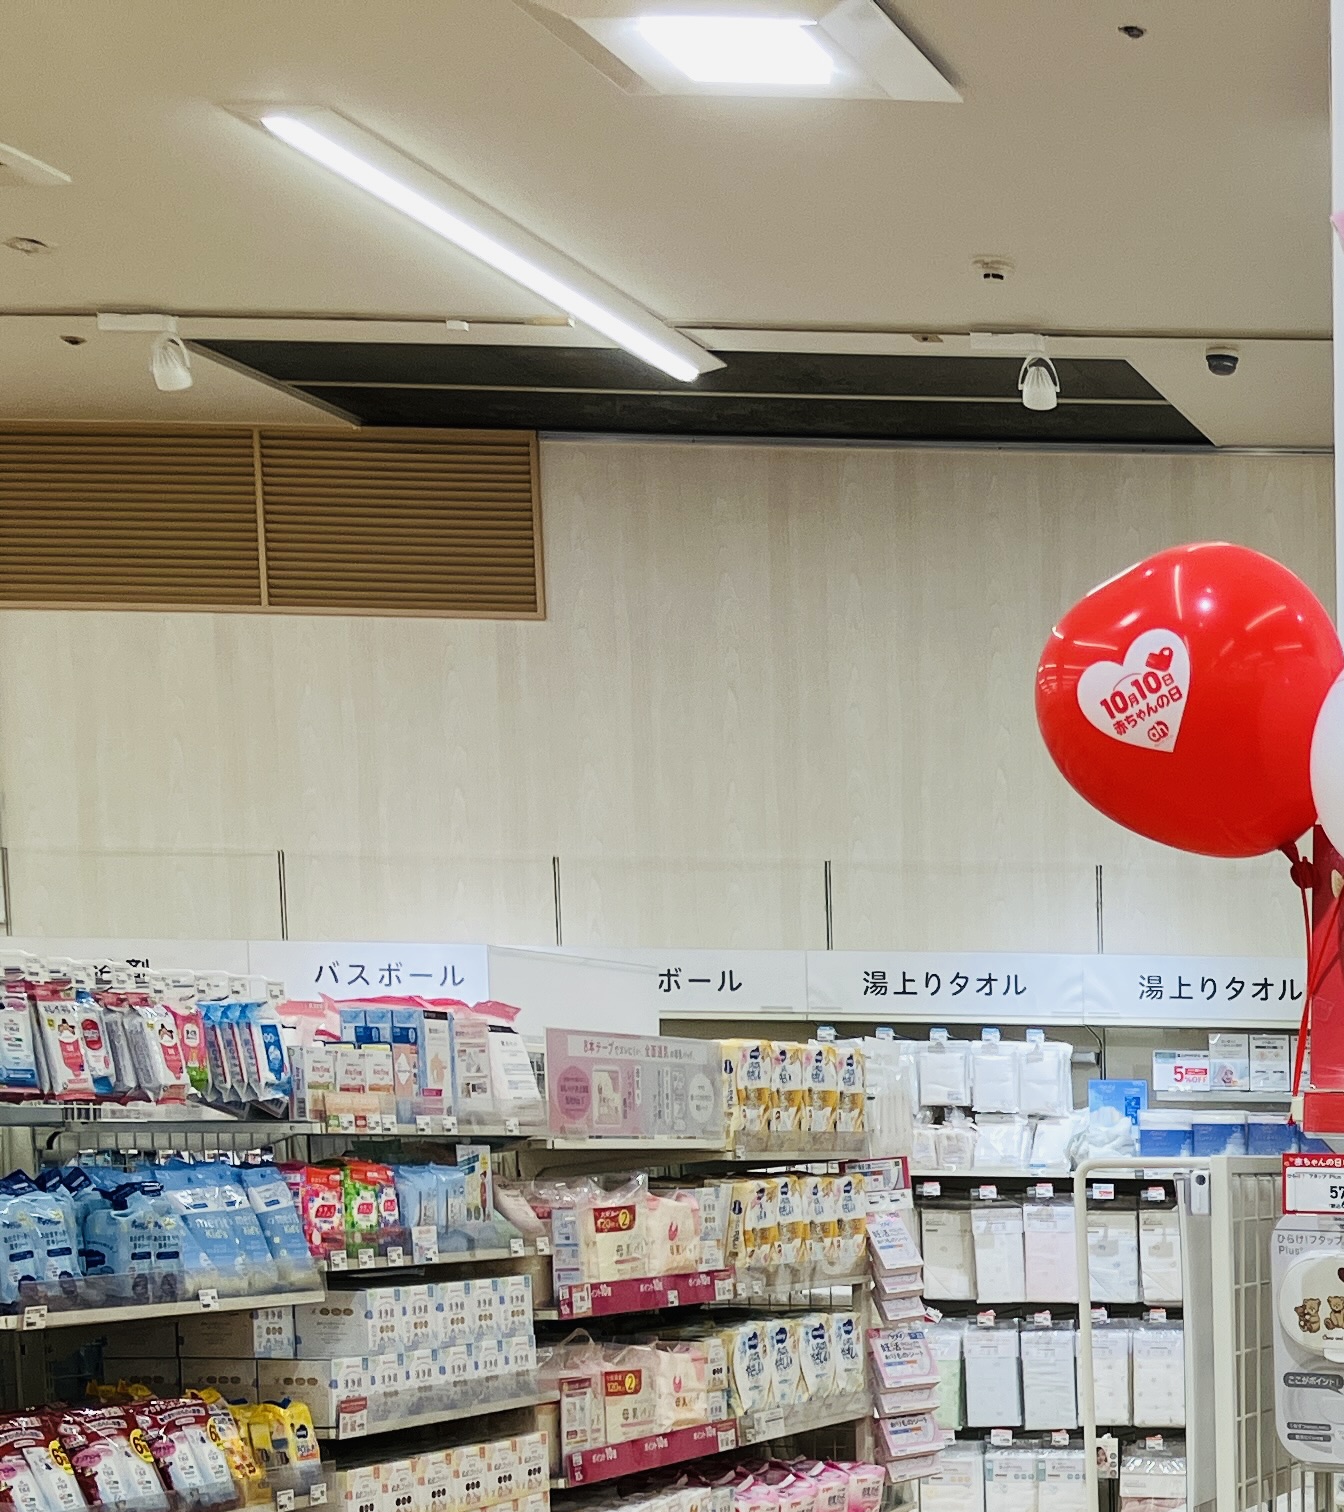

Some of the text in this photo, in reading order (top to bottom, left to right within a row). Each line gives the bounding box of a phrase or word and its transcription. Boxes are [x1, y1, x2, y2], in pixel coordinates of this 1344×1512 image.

[1100, 671, 1175, 719] 10月10日
[1112, 685, 1182, 736] 赤ちゃんの日
[315, 961, 465, 987] バスボール
[659, 968, 742, 993] ボール
[862, 970, 1027, 997] 湯上りタオル
[1138, 975, 1303, 1001] 湯上りタオル
